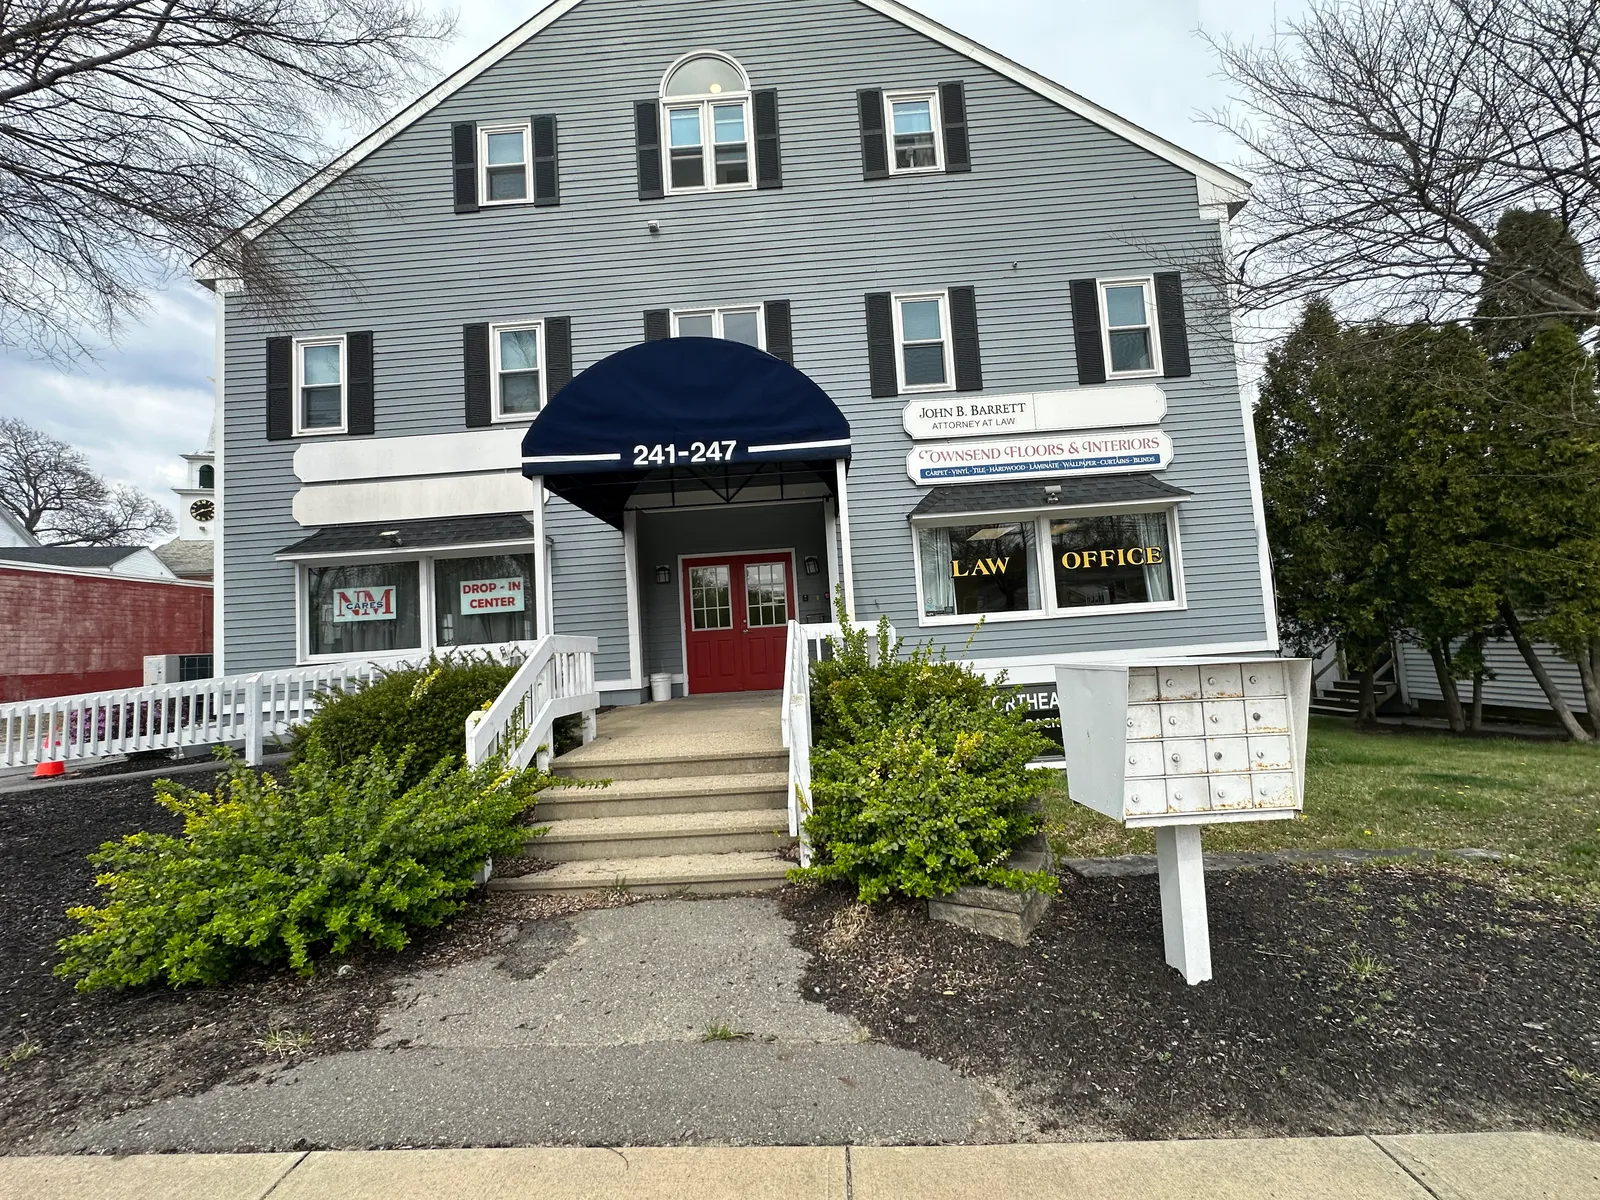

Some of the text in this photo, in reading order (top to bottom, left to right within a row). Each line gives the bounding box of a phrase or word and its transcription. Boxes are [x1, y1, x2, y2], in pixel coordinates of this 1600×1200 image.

[919, 402, 1026, 418] JOHN B. BARRETT
[932, 418, 1015, 430] ATTORNEY AT LAW
[633, 440, 737, 465] 241-247
[918, 437, 1160, 463] TOWNSEND FLOORS & INTERIORS
[925, 455, 1156, 477] CARPET VINYL TILE HARDWOOD LAMINATE WALLPAPER CURTAINS BLINDS
[951, 546, 1164, 578] LAW OFFICE
[463, 583, 496, 594] DROP
[508, 581, 521, 591] IN
[346, 601, 383, 610] CARES
[469, 596, 515, 609] CENTER
